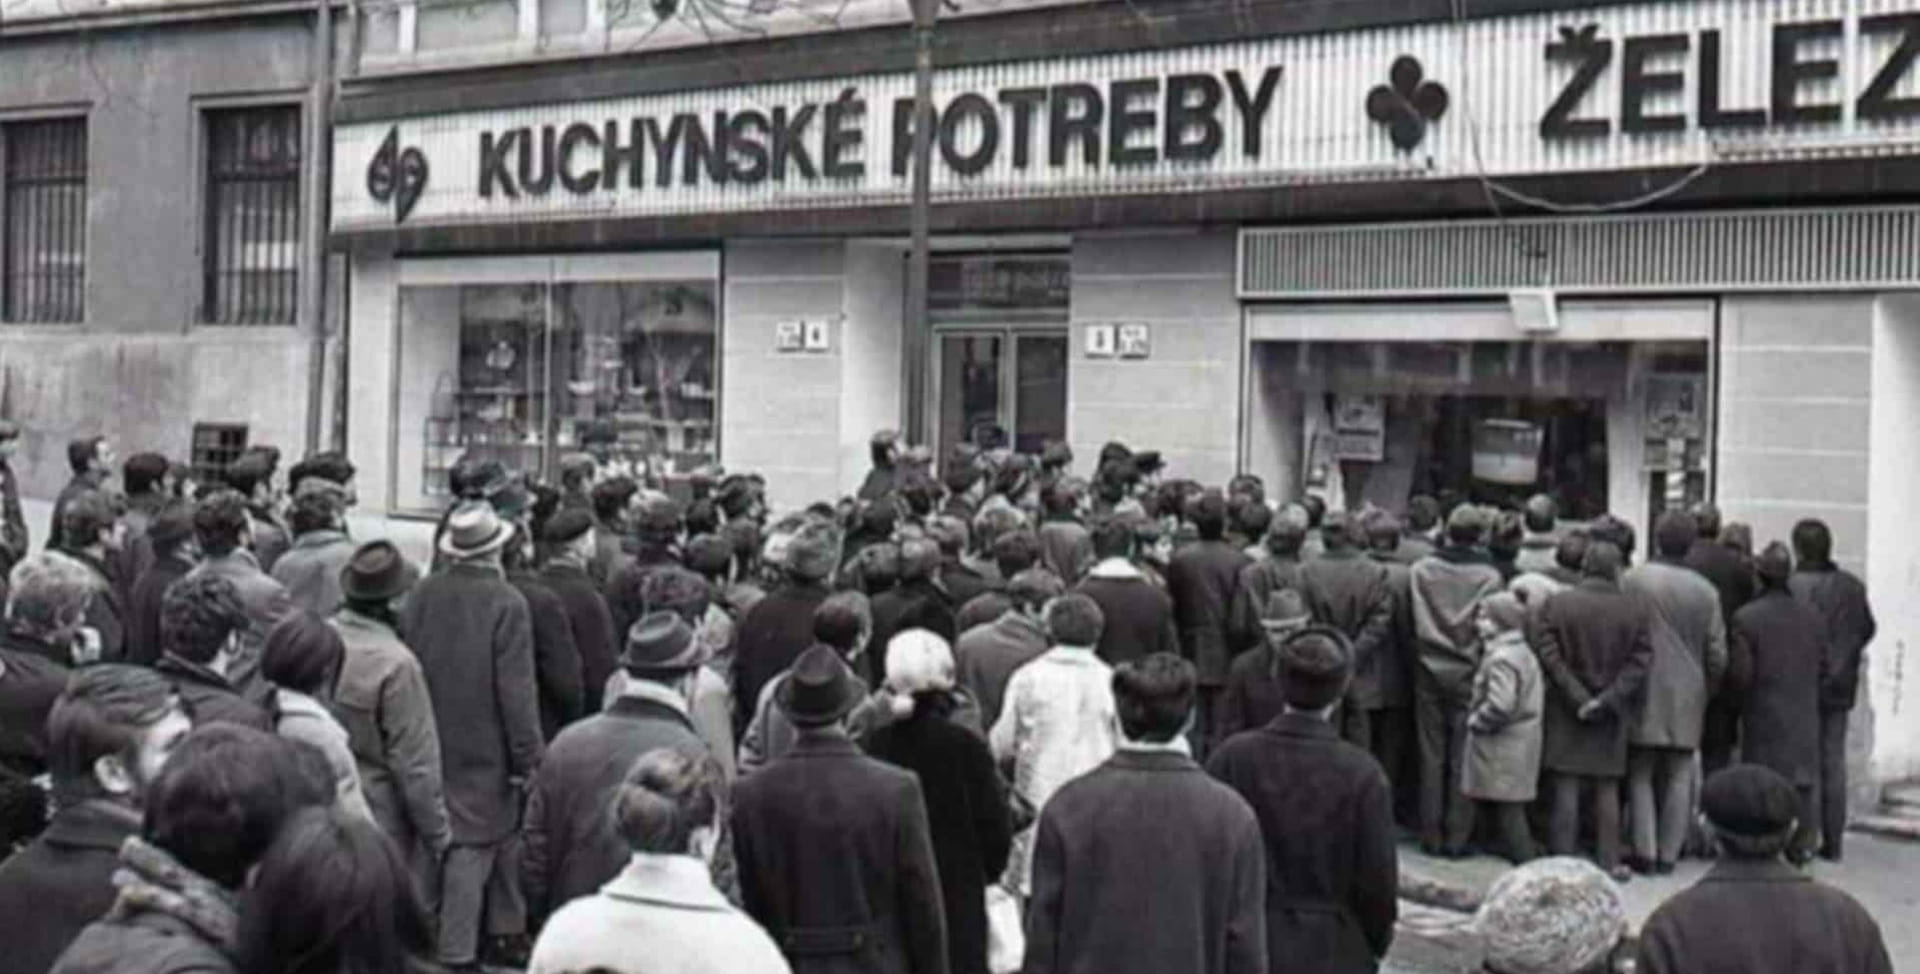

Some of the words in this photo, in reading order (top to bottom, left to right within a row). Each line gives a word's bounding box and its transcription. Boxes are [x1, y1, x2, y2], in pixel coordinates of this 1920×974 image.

[479, 88, 866, 197] KUCHYNSKÉ
[891, 66, 1283, 176] POTREBY
[1540, 13, 1920, 138] ŽELEZ
